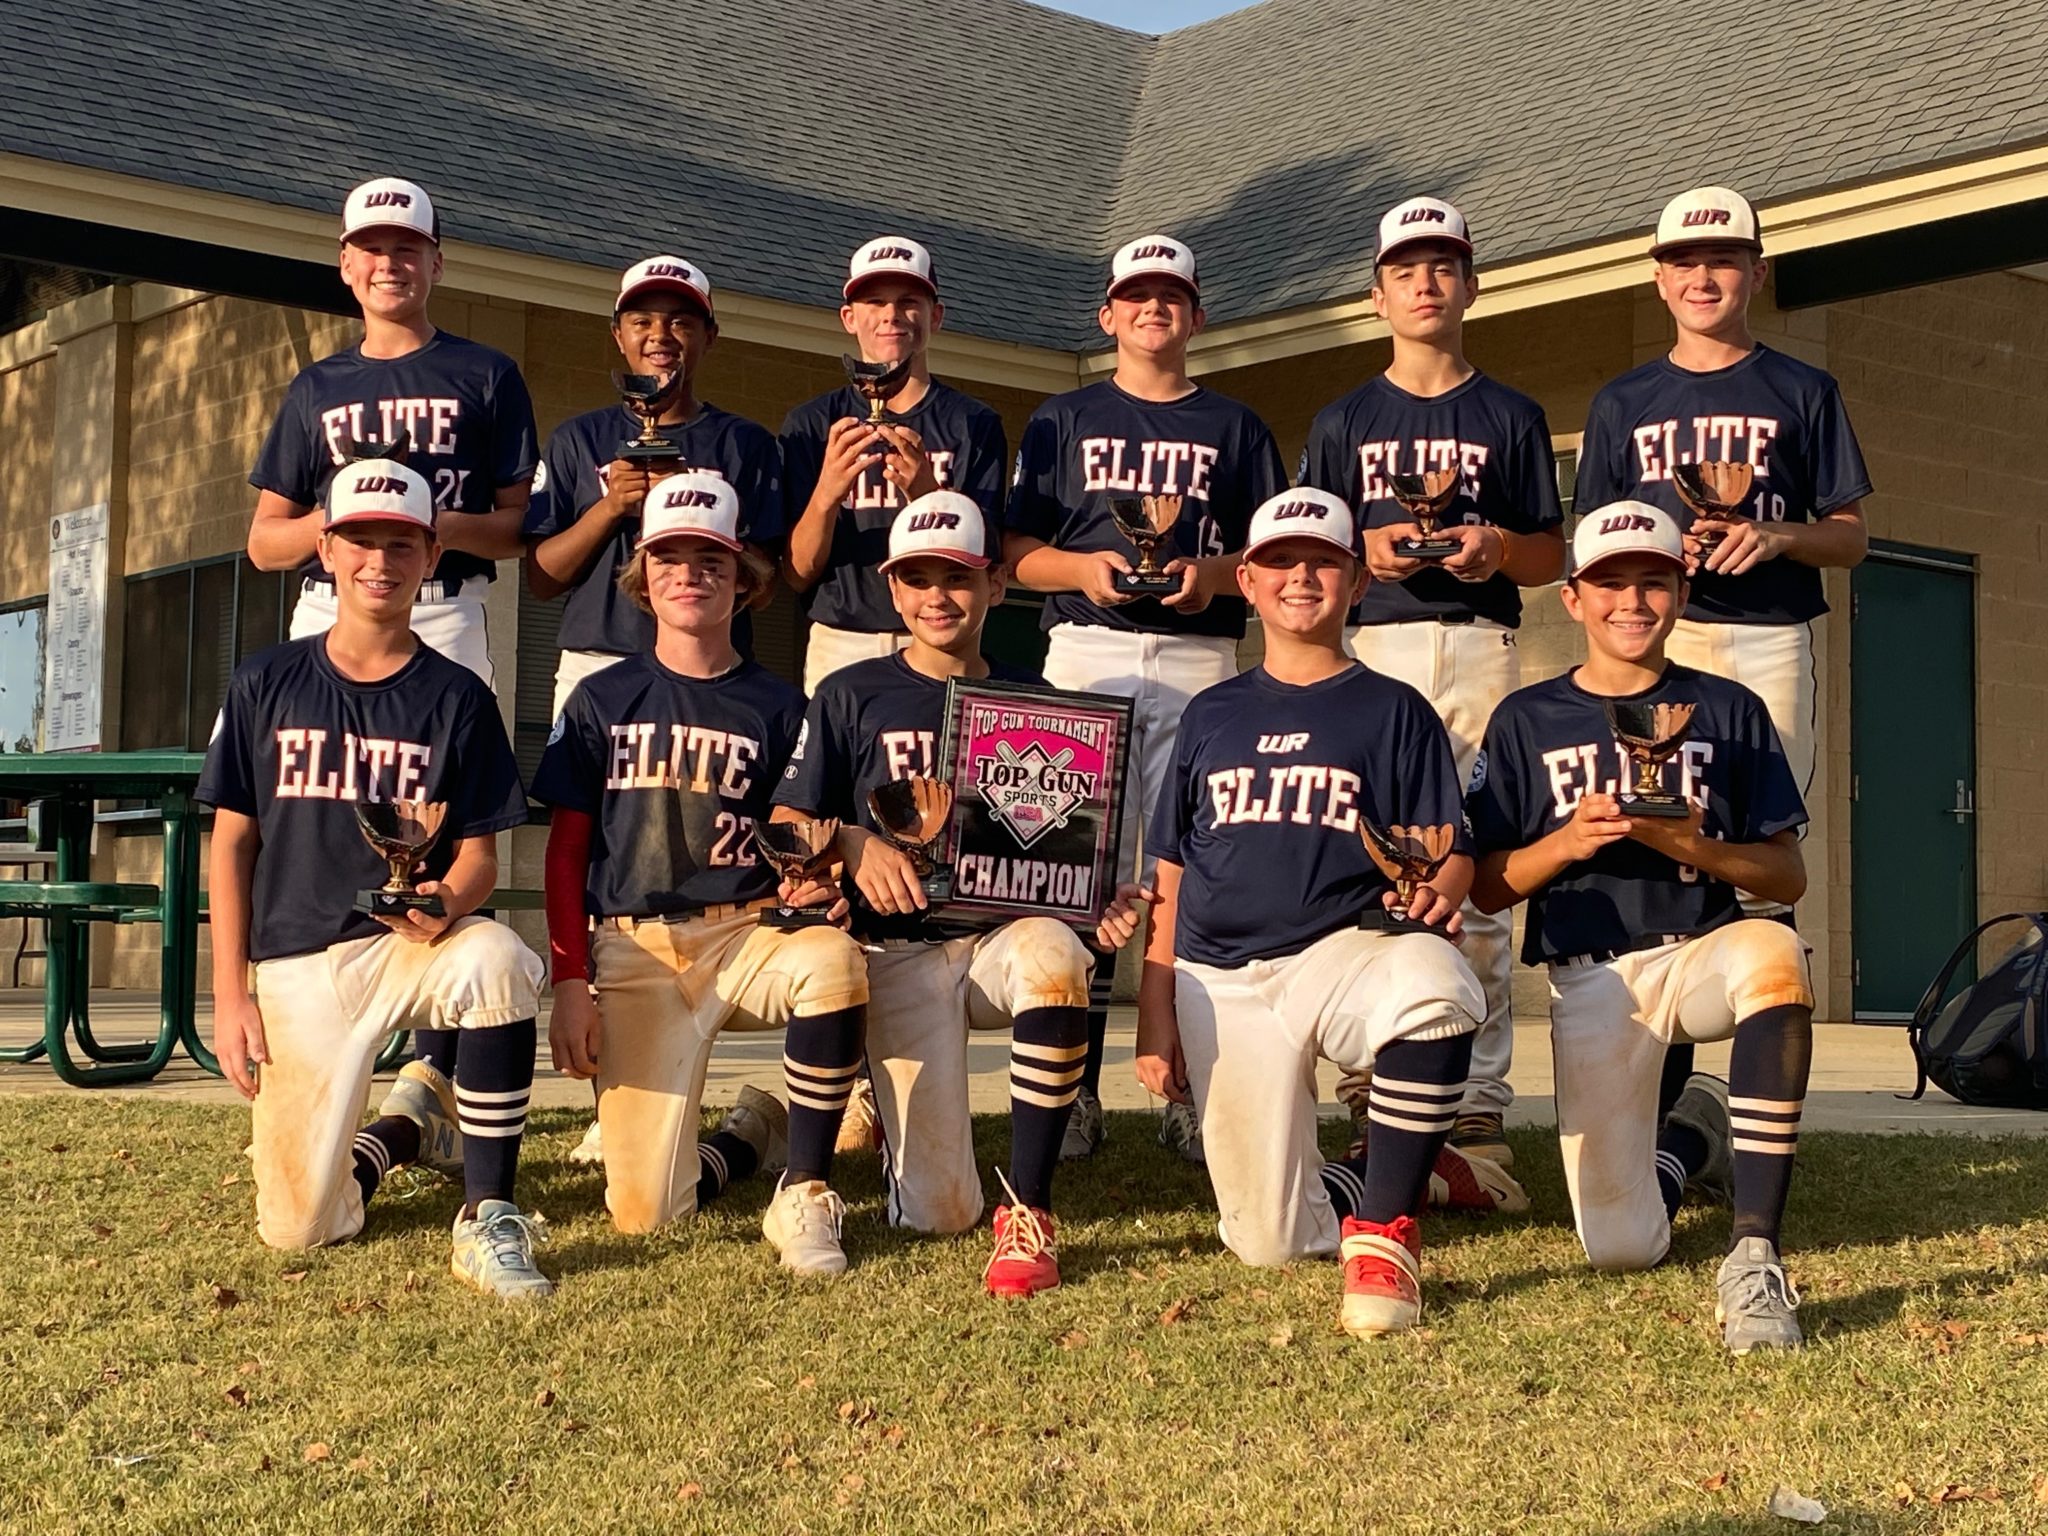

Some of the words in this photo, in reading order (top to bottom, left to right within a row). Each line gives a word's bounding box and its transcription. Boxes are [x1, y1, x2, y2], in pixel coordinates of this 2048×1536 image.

[364, 192, 412, 209] WR
[1400, 208, 1446, 225] WR
[1682, 208, 1732, 227] WR
[868, 246, 913, 262] WR
[1131, 245, 1178, 261] WR
[645, 264, 692, 282] WR
[1632, 414, 1778, 482] ELITE
[1081, 437, 1219, 501] ELITE
[354, 476, 409, 496] WR
[434, 468, 472, 511] 21
[664, 490, 718, 510] WR
[1274, 501, 1329, 521] WR
[908, 512, 961, 532] WR
[1599, 514, 1656, 536] WR
[975, 709, 999, 738] TOP
[1001, 712, 1025, 731] GUN
[1028, 715, 1105, 752] TOURNAMENT
[1256, 732, 1311, 754] WR
[275, 728, 431, 805] ELITE
[606, 722, 760, 800] ELITE
[976, 756, 1029, 788] TOP
[1038, 764, 1096, 797] GUN
[1003, 790, 1058, 808] SPORTS
[1207, 764, 1362, 834] ELITE
[710, 811, 757, 867] 22
[957, 853, 1092, 907] CHAMPION
